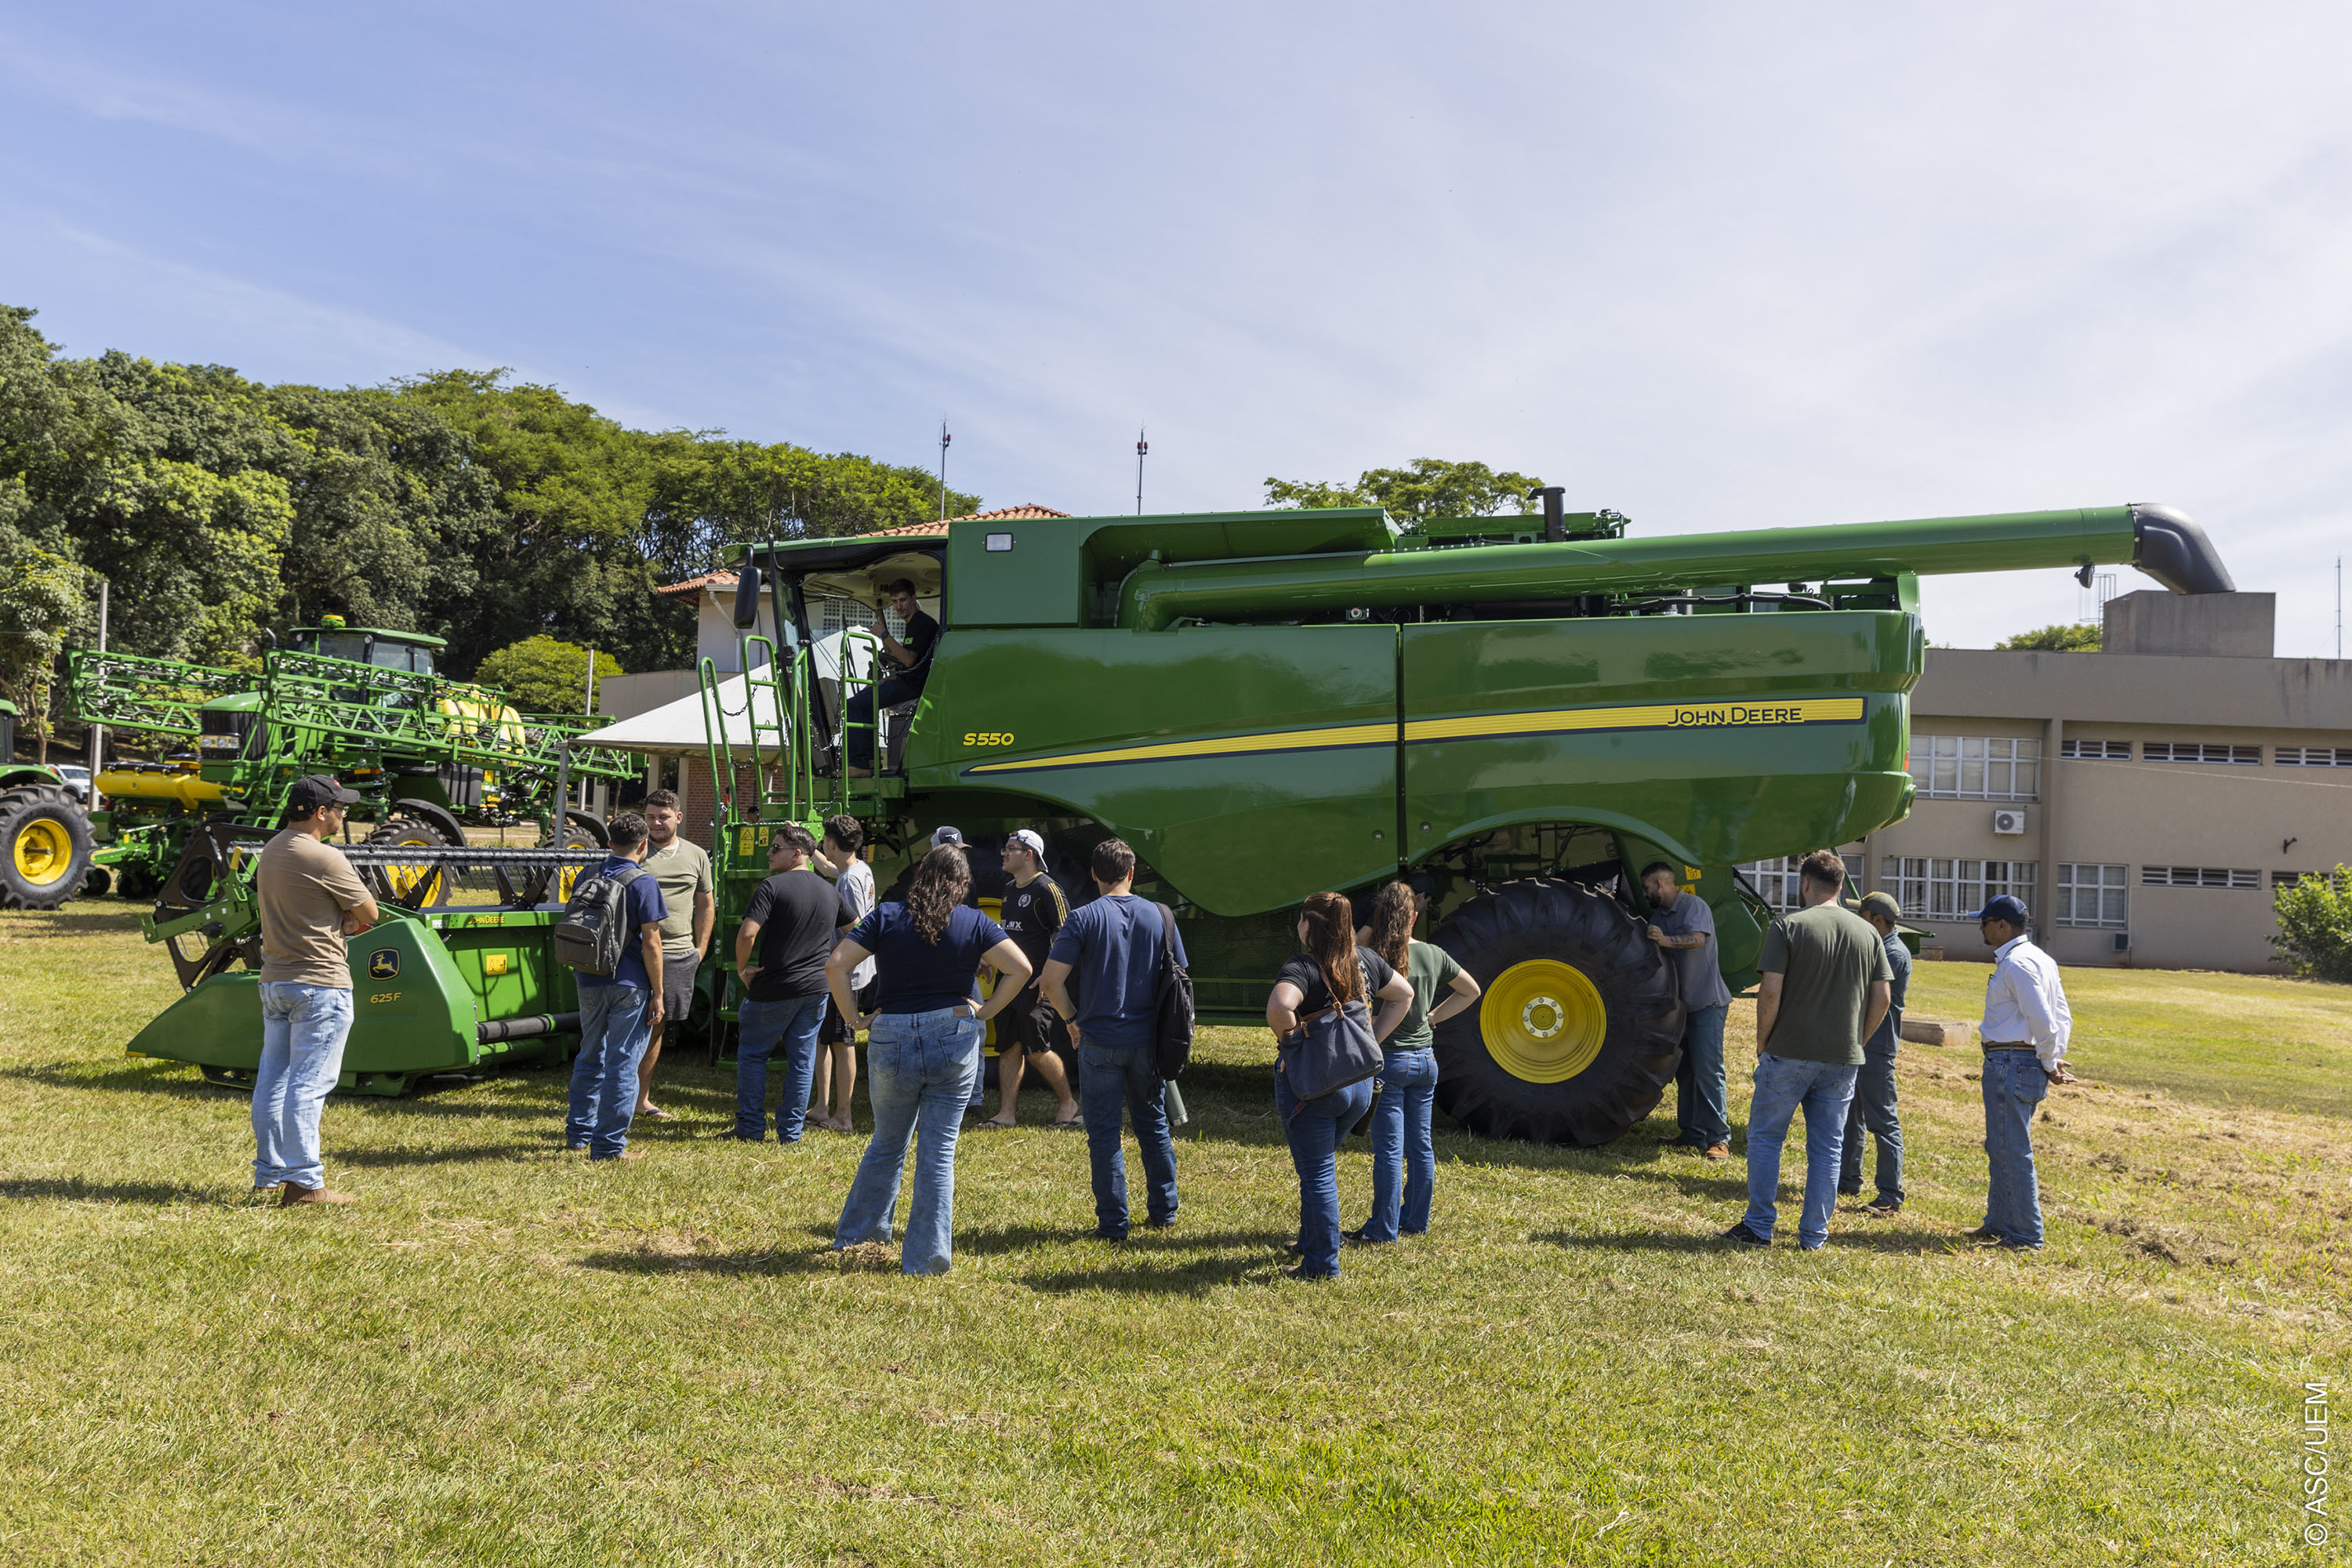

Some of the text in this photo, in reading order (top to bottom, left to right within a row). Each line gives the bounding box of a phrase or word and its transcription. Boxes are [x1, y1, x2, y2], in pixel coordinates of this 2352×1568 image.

[1668, 707, 1802, 724] JOHN DEERE
[963, 732, 1014, 746] S550
[468, 915, 506, 924] JOHN DEERE
[370, 992, 401, 1004] 625F
